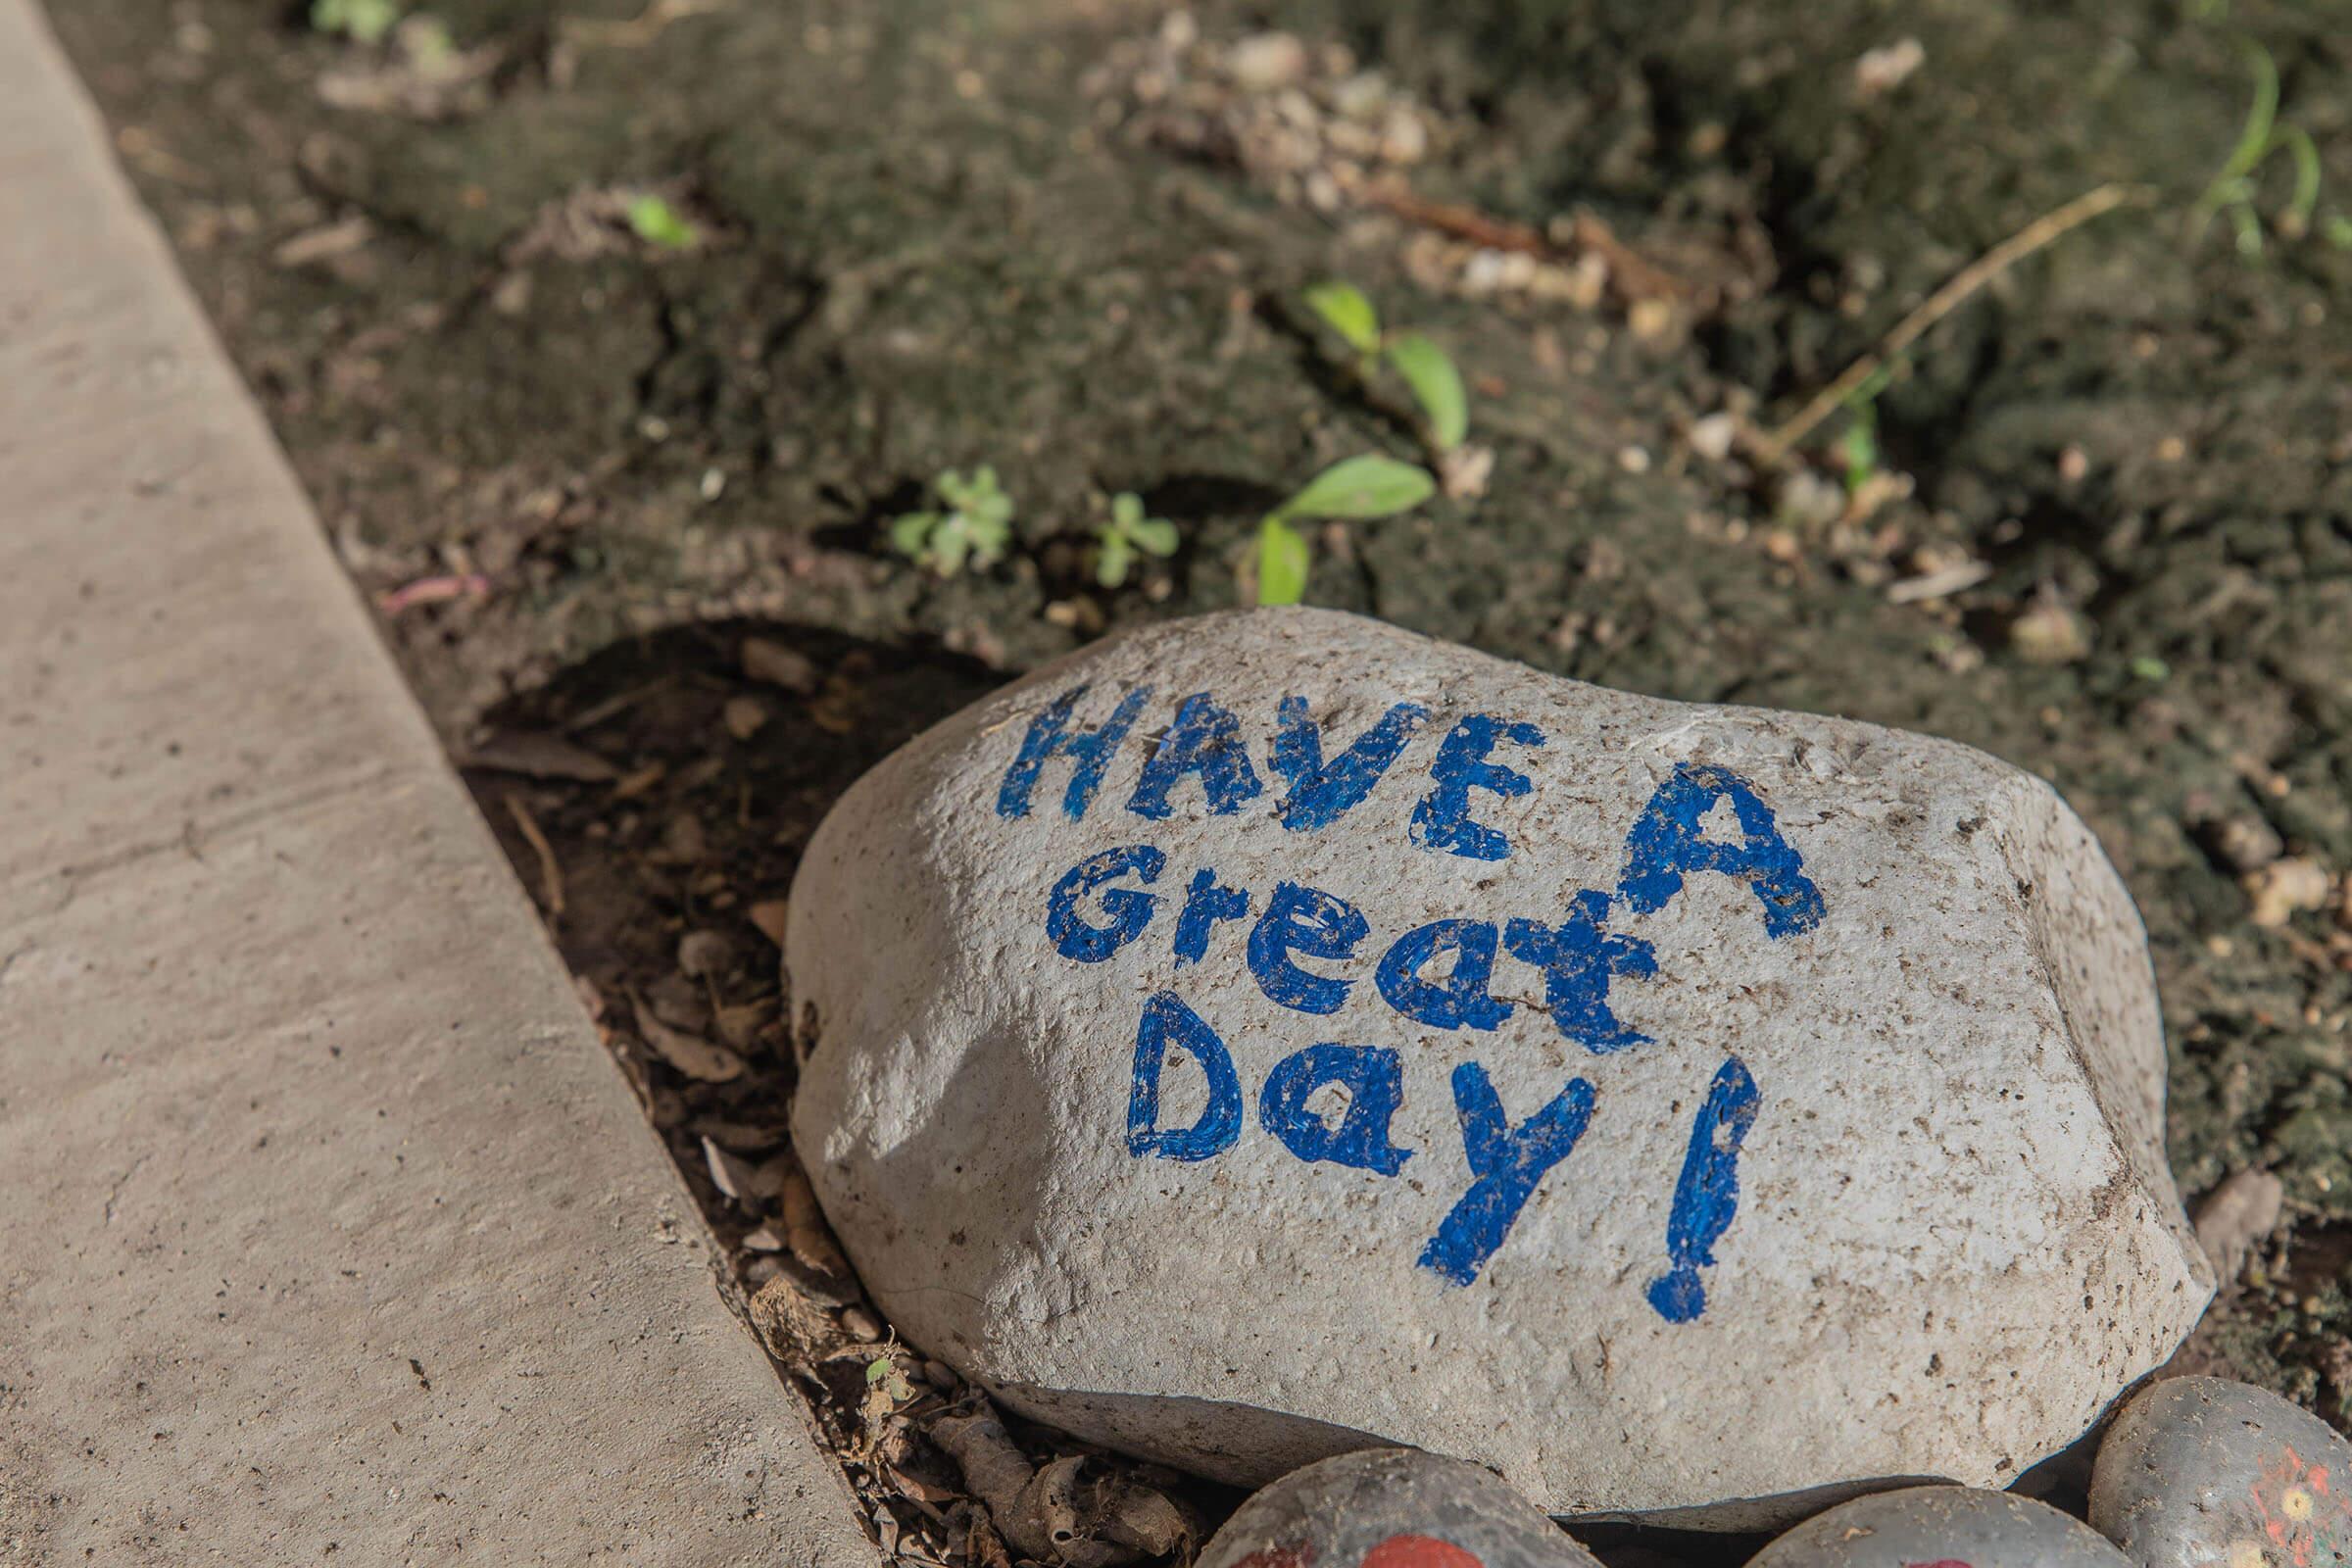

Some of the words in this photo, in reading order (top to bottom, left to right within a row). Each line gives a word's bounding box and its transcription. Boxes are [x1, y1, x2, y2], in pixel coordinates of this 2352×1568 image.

[996, 686, 1546, 861] HAVE
[1617, 761, 1827, 940] A
[1046, 845, 1658, 1054] Great
